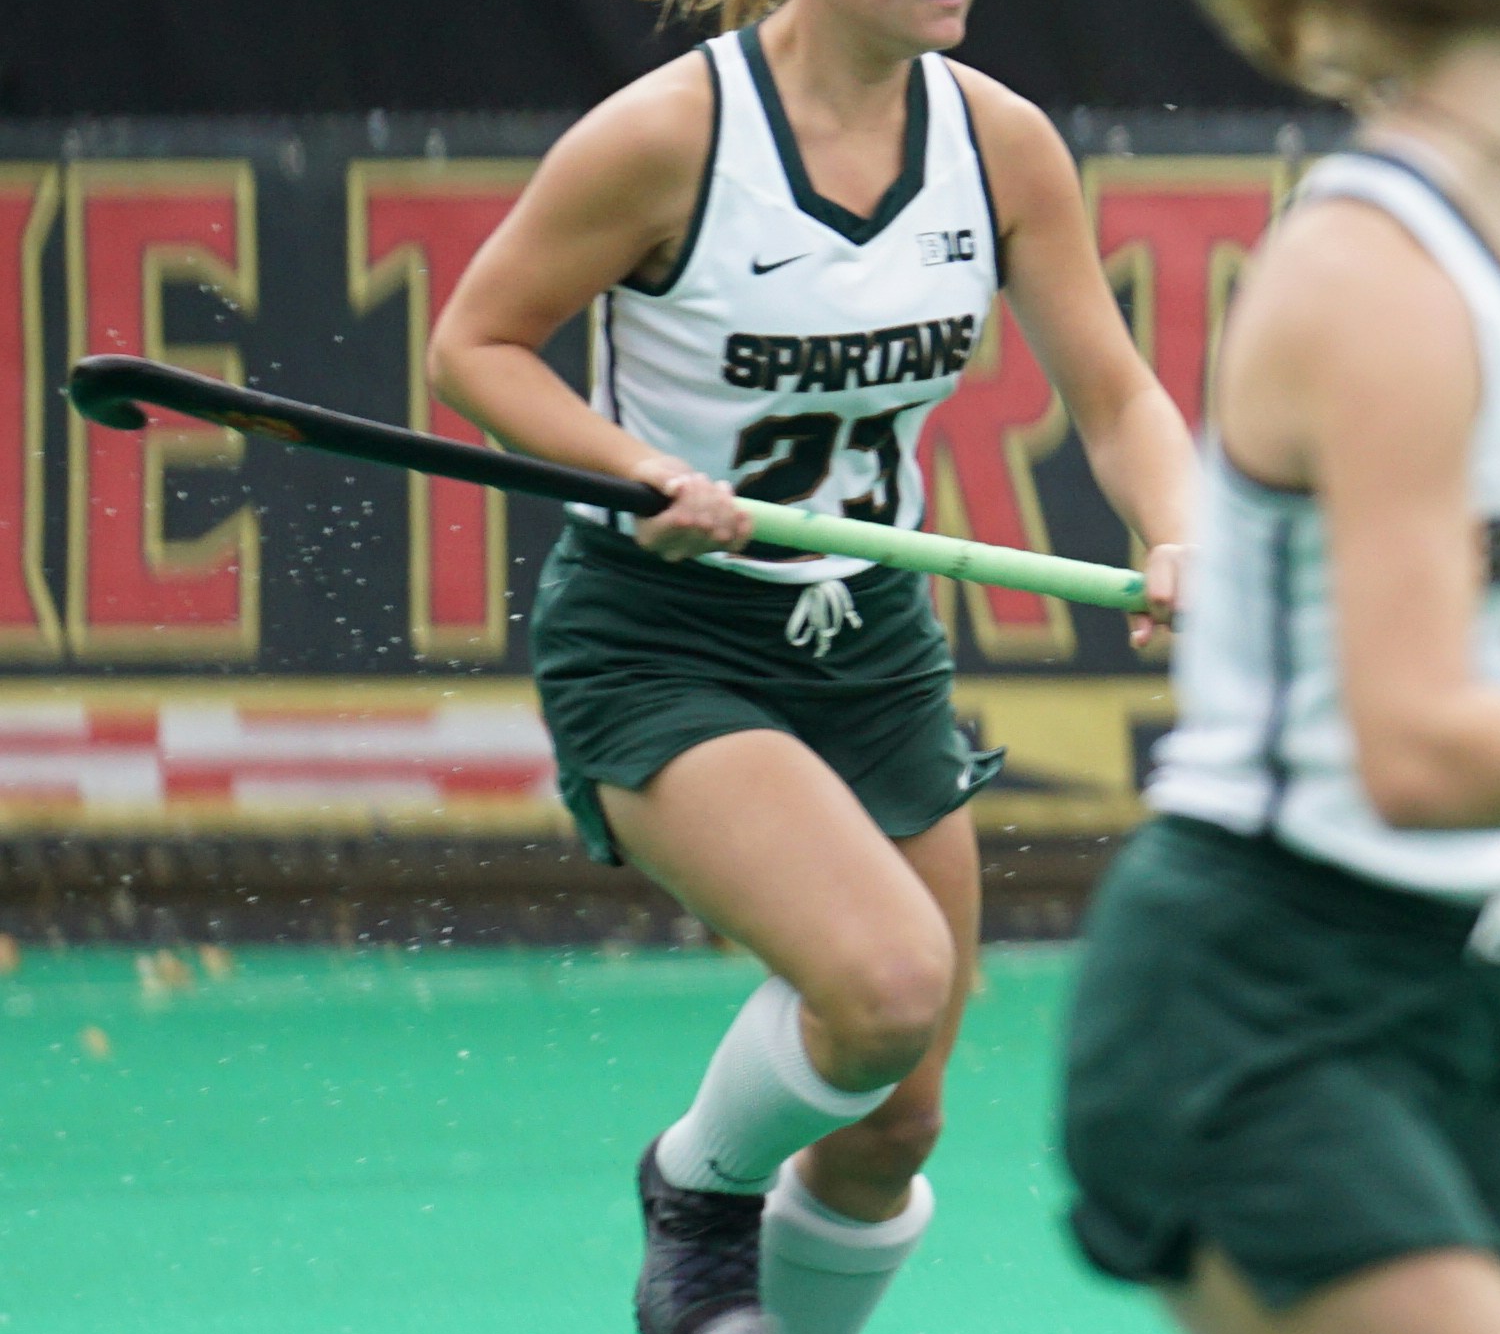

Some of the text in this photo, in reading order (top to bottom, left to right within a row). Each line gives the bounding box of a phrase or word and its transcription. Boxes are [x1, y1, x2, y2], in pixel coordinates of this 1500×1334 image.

[0, 158, 259, 660] E
[722, 313, 975, 394] SPARTANS
[730, 398, 934, 564] 23
